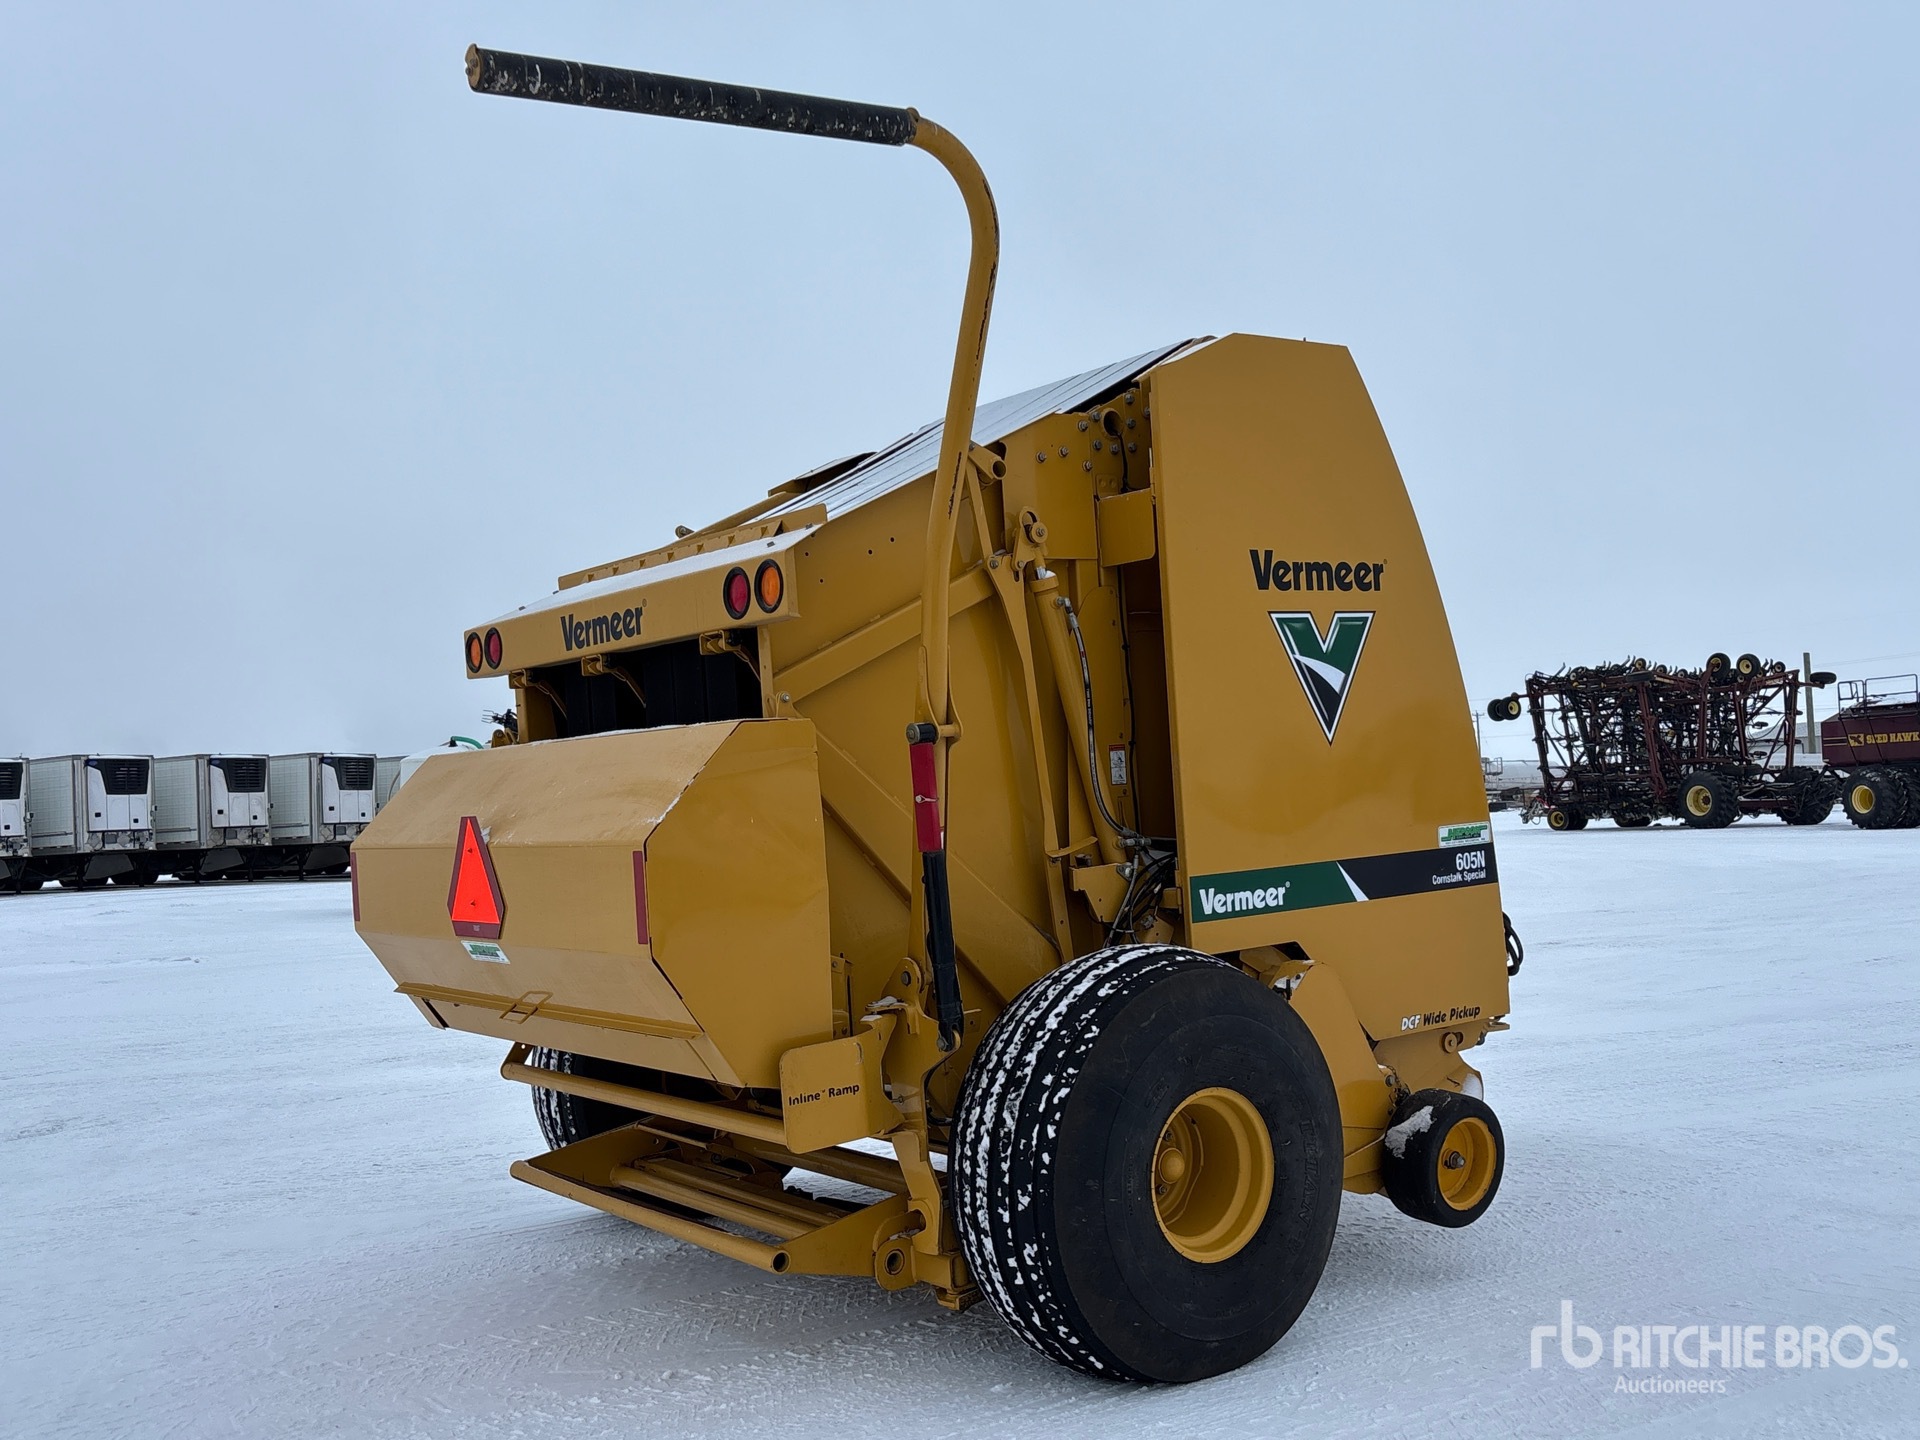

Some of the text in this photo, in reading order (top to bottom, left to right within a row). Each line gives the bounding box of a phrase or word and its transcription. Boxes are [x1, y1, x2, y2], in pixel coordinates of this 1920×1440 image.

[1249, 549, 1385, 592] Vermeer
[560, 605, 644, 652] Vermeer
[1889, 731, 1920, 743] HAWK
[1455, 850, 1486, 871] 605N
[1432, 868, 1487, 885] Cornstalk Special
[1199, 886, 1287, 915] Vermeer
[1401, 1005, 1481, 1031] DCF Wide Pickup
[788, 1084, 860, 1106] Inline Ramp
